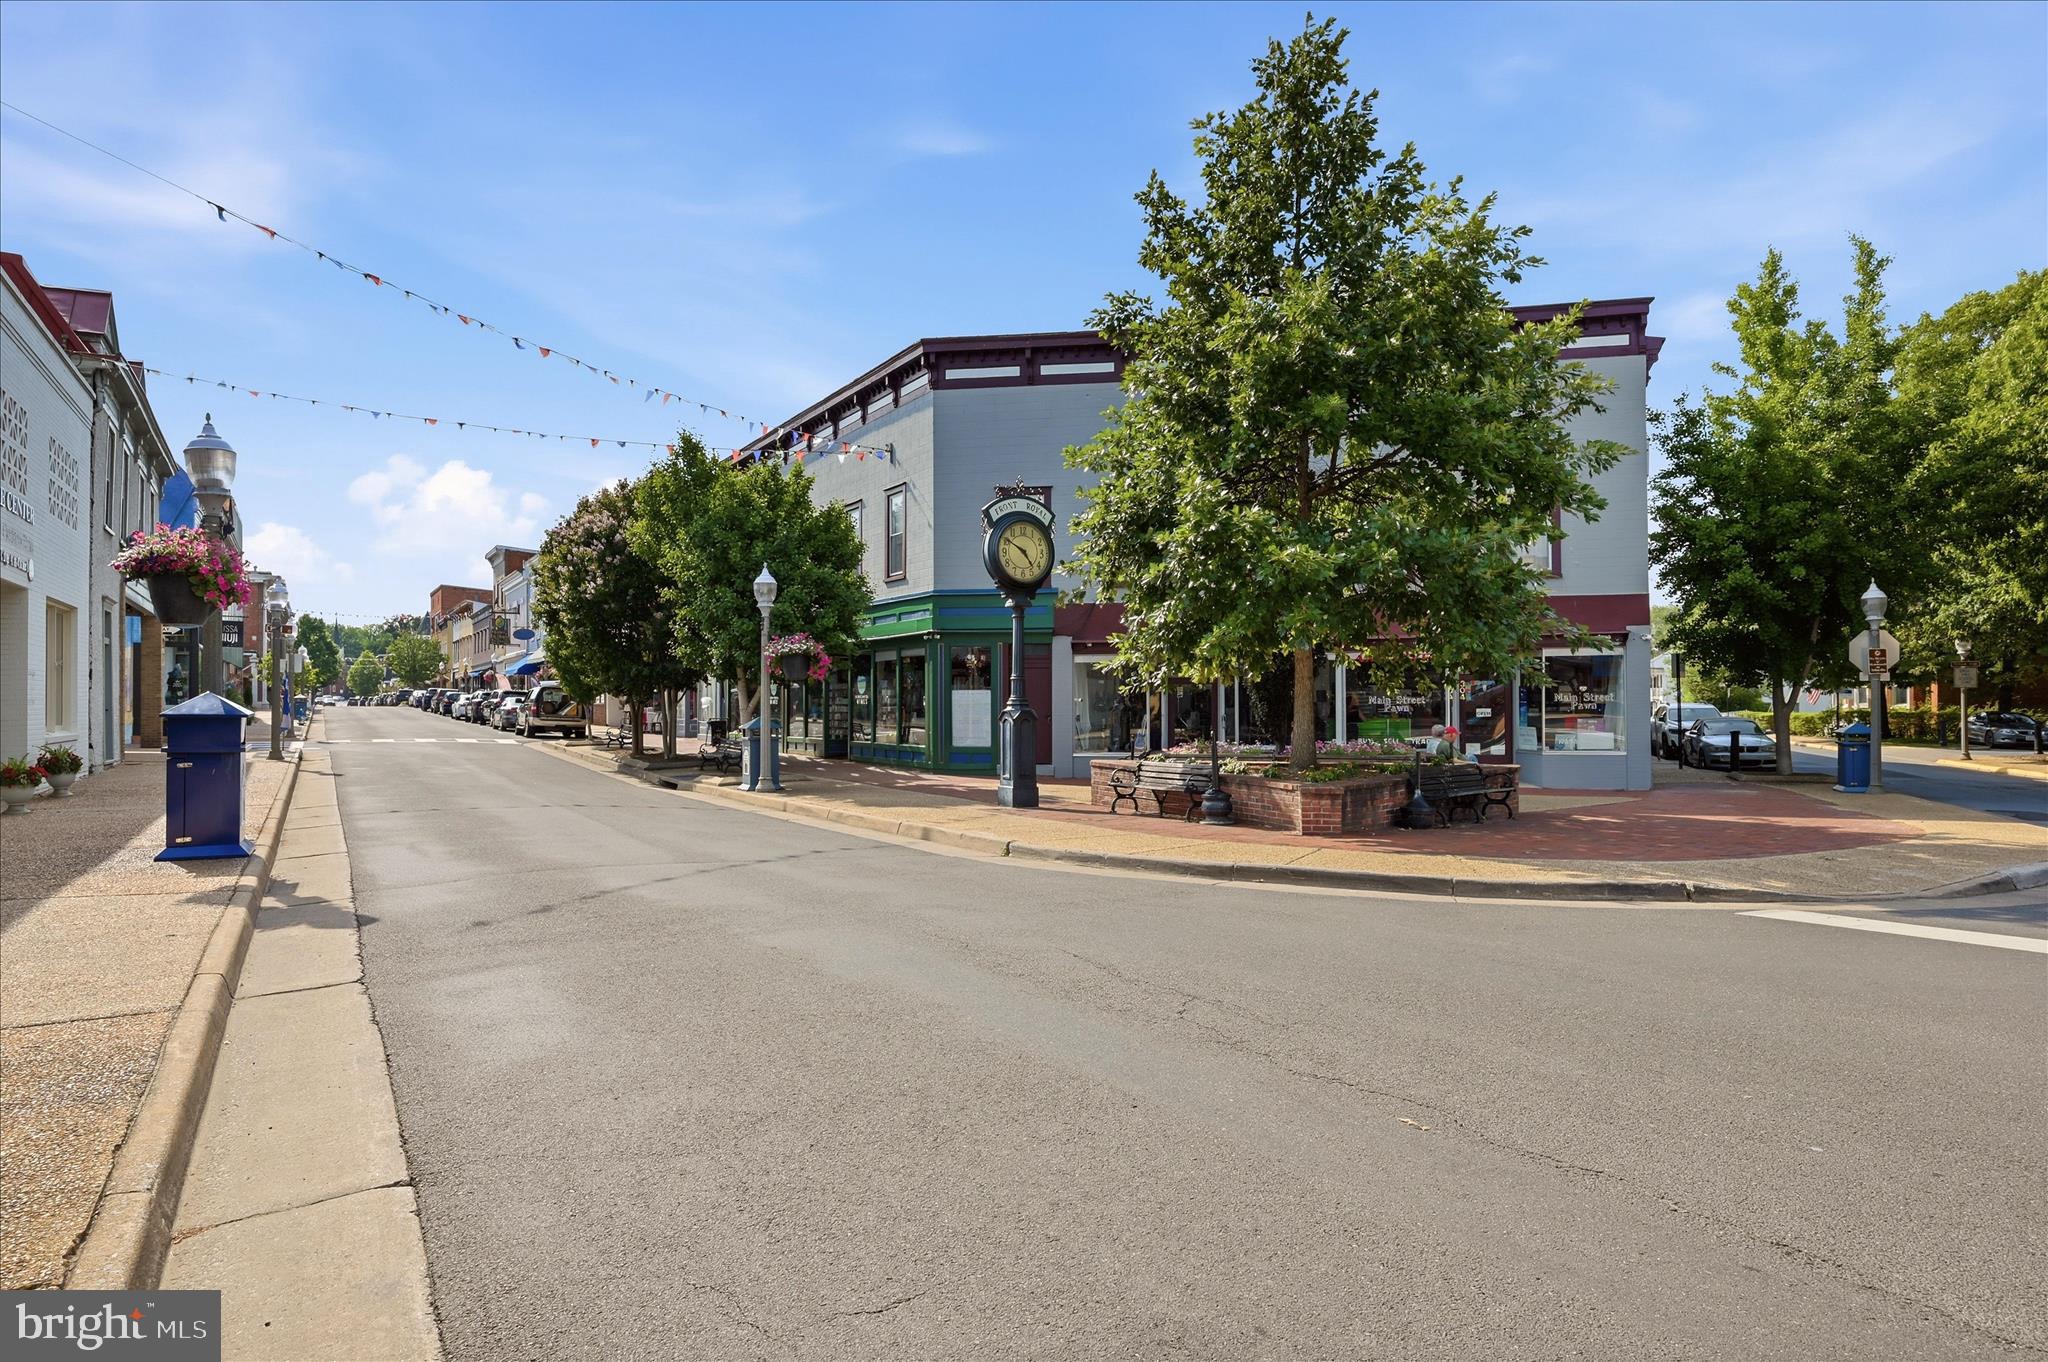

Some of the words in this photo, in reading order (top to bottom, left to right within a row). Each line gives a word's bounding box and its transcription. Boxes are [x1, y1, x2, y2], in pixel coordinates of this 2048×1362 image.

[6, 491, 34, 525] CENTER
[994, 501, 1018, 516] FRONT
[1026, 502, 1047, 520] ROYAL
[1368, 696, 1391, 705] Main
[1396, 695, 1426, 705] Street
[1554, 693, 1578, 702] Main
[1583, 692, 1615, 702] Street
[1384, 704, 1410, 713] Pawn
[1571, 702, 1597, 710] Pawn
